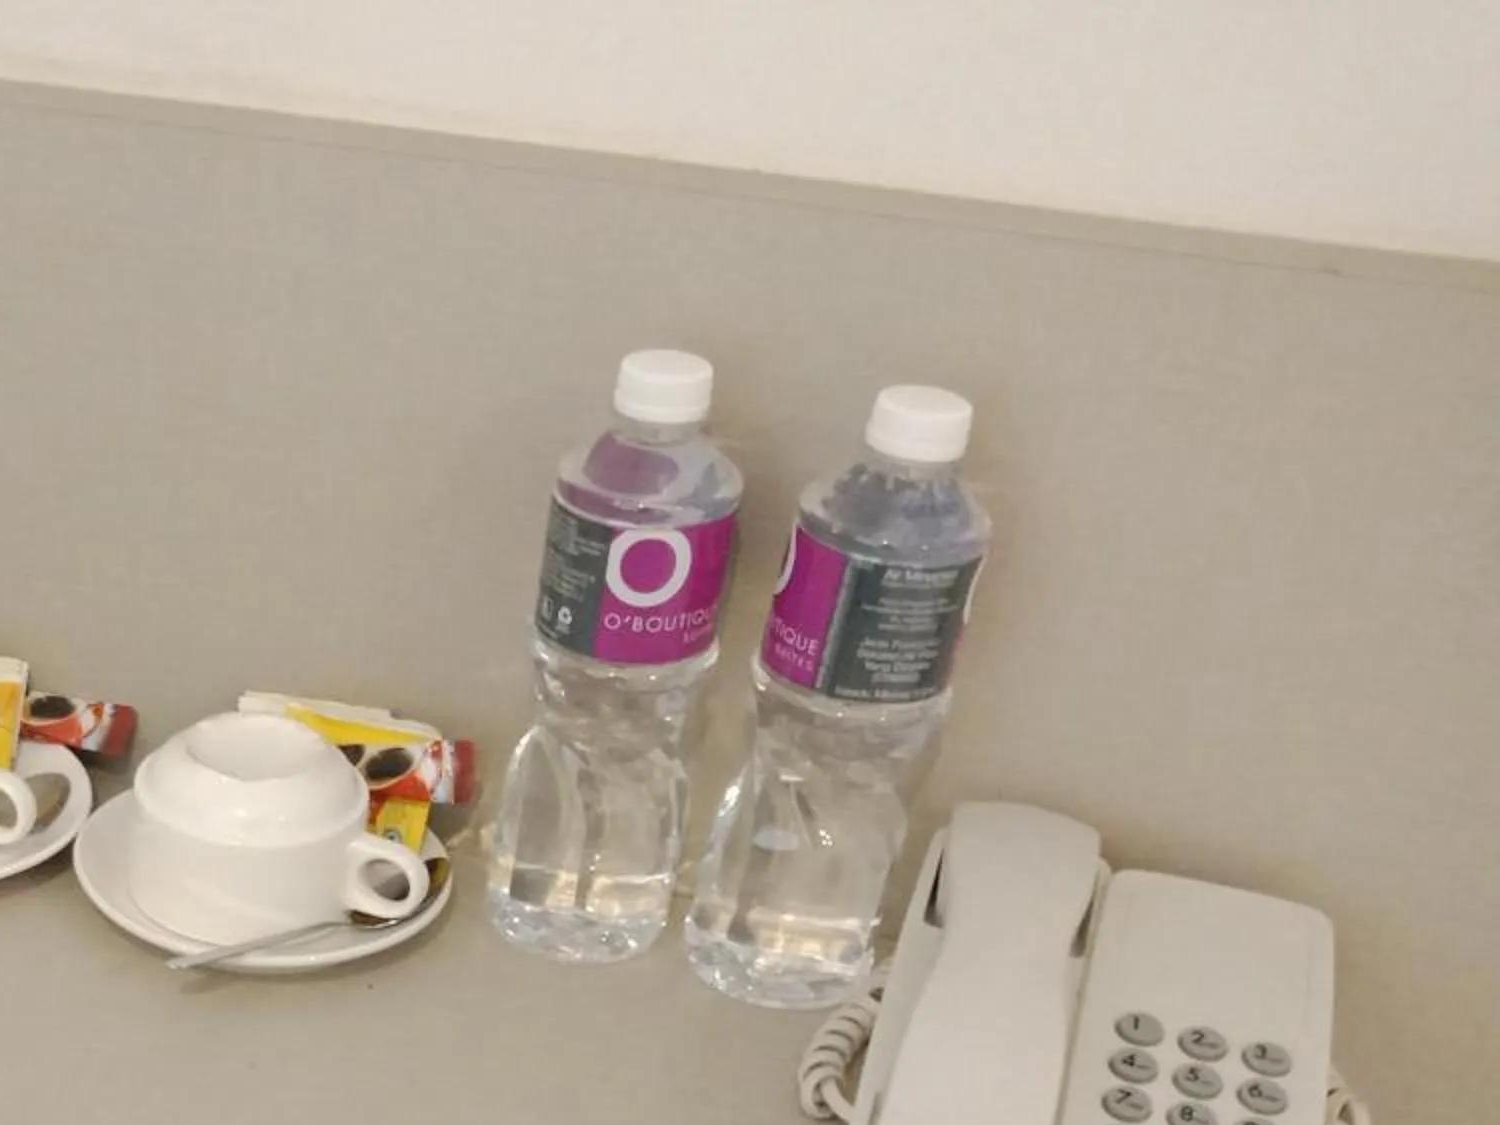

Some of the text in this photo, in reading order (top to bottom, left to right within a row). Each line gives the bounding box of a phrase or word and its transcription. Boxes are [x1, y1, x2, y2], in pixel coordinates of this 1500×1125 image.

[1132, 1014, 1141, 1032] 1
[1190, 1029, 1206, 1045] 2
[1254, 1043, 1268, 1060] 3
[1121, 1053, 1137, 1068] 4
[1185, 1066, 1201, 1083] 5
[1115, 1088, 1133, 1105] 7
[1248, 1083, 1263, 1098] 6
[1179, 1105, 1195, 1122] 8
